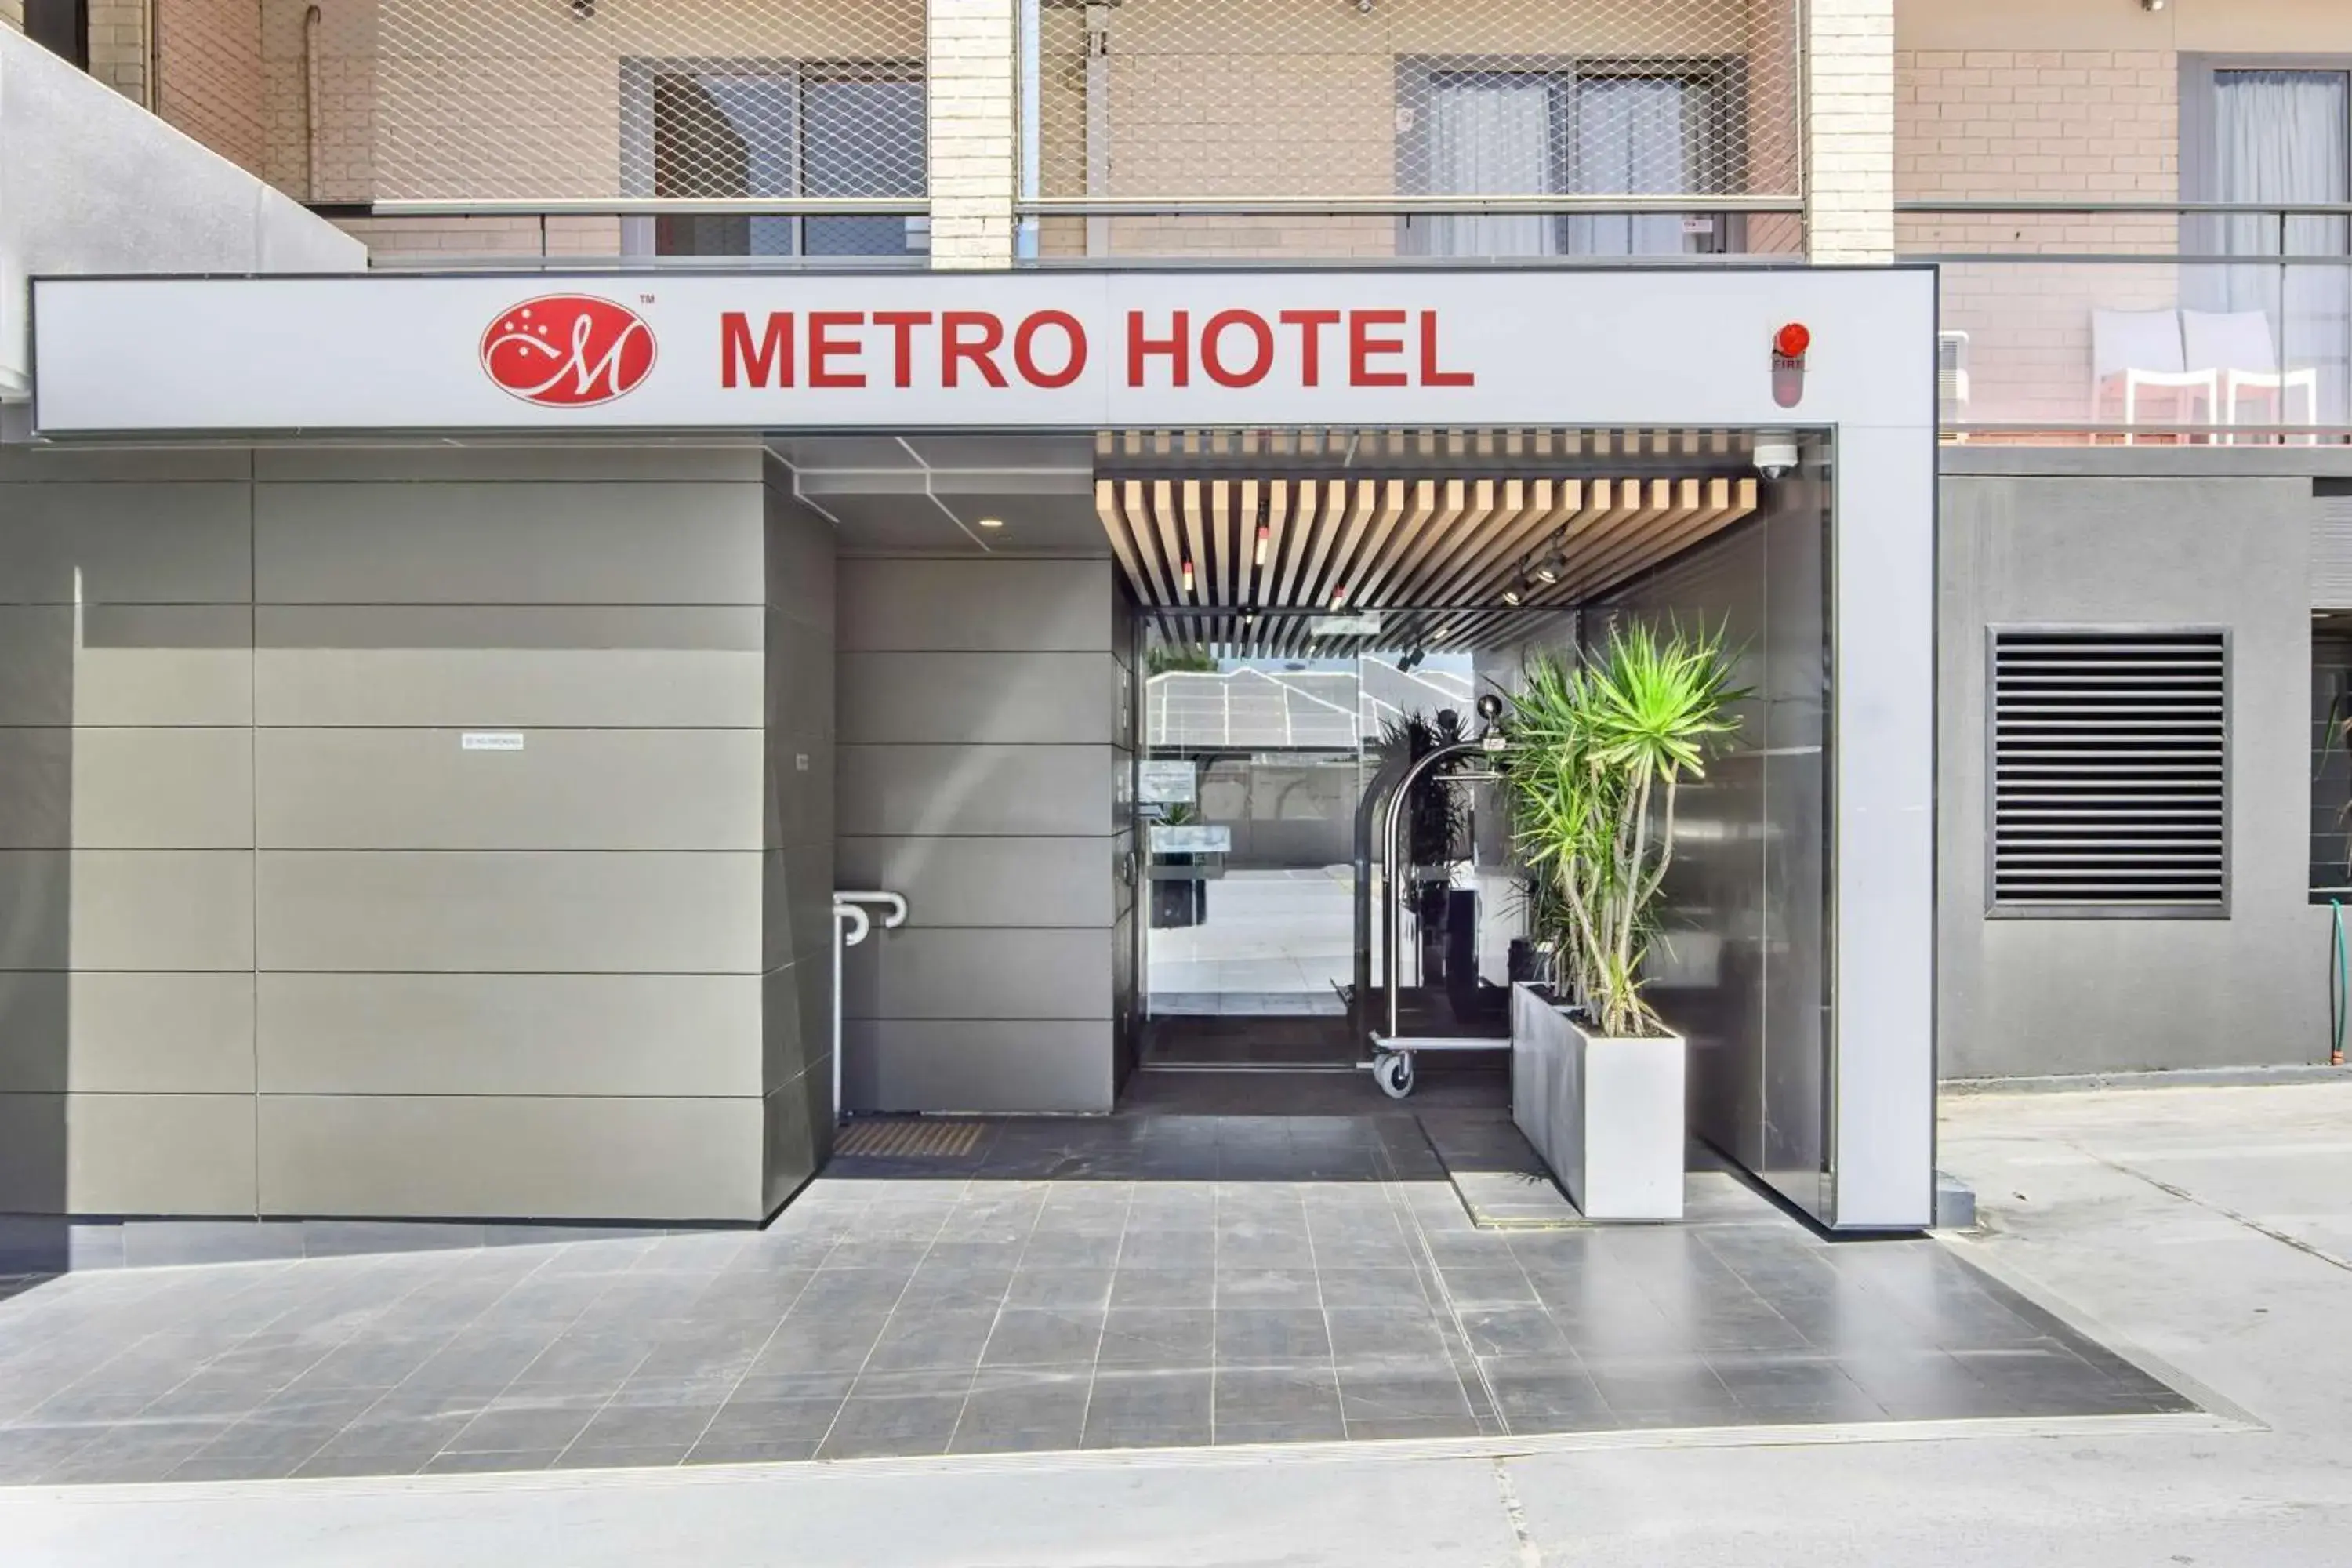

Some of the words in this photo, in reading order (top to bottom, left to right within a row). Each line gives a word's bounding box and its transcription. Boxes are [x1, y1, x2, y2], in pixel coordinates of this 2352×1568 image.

[639, 293, 655, 303] TM
[720, 309, 1087, 389] METRO
[1127, 309, 1475, 387] HOTEL
